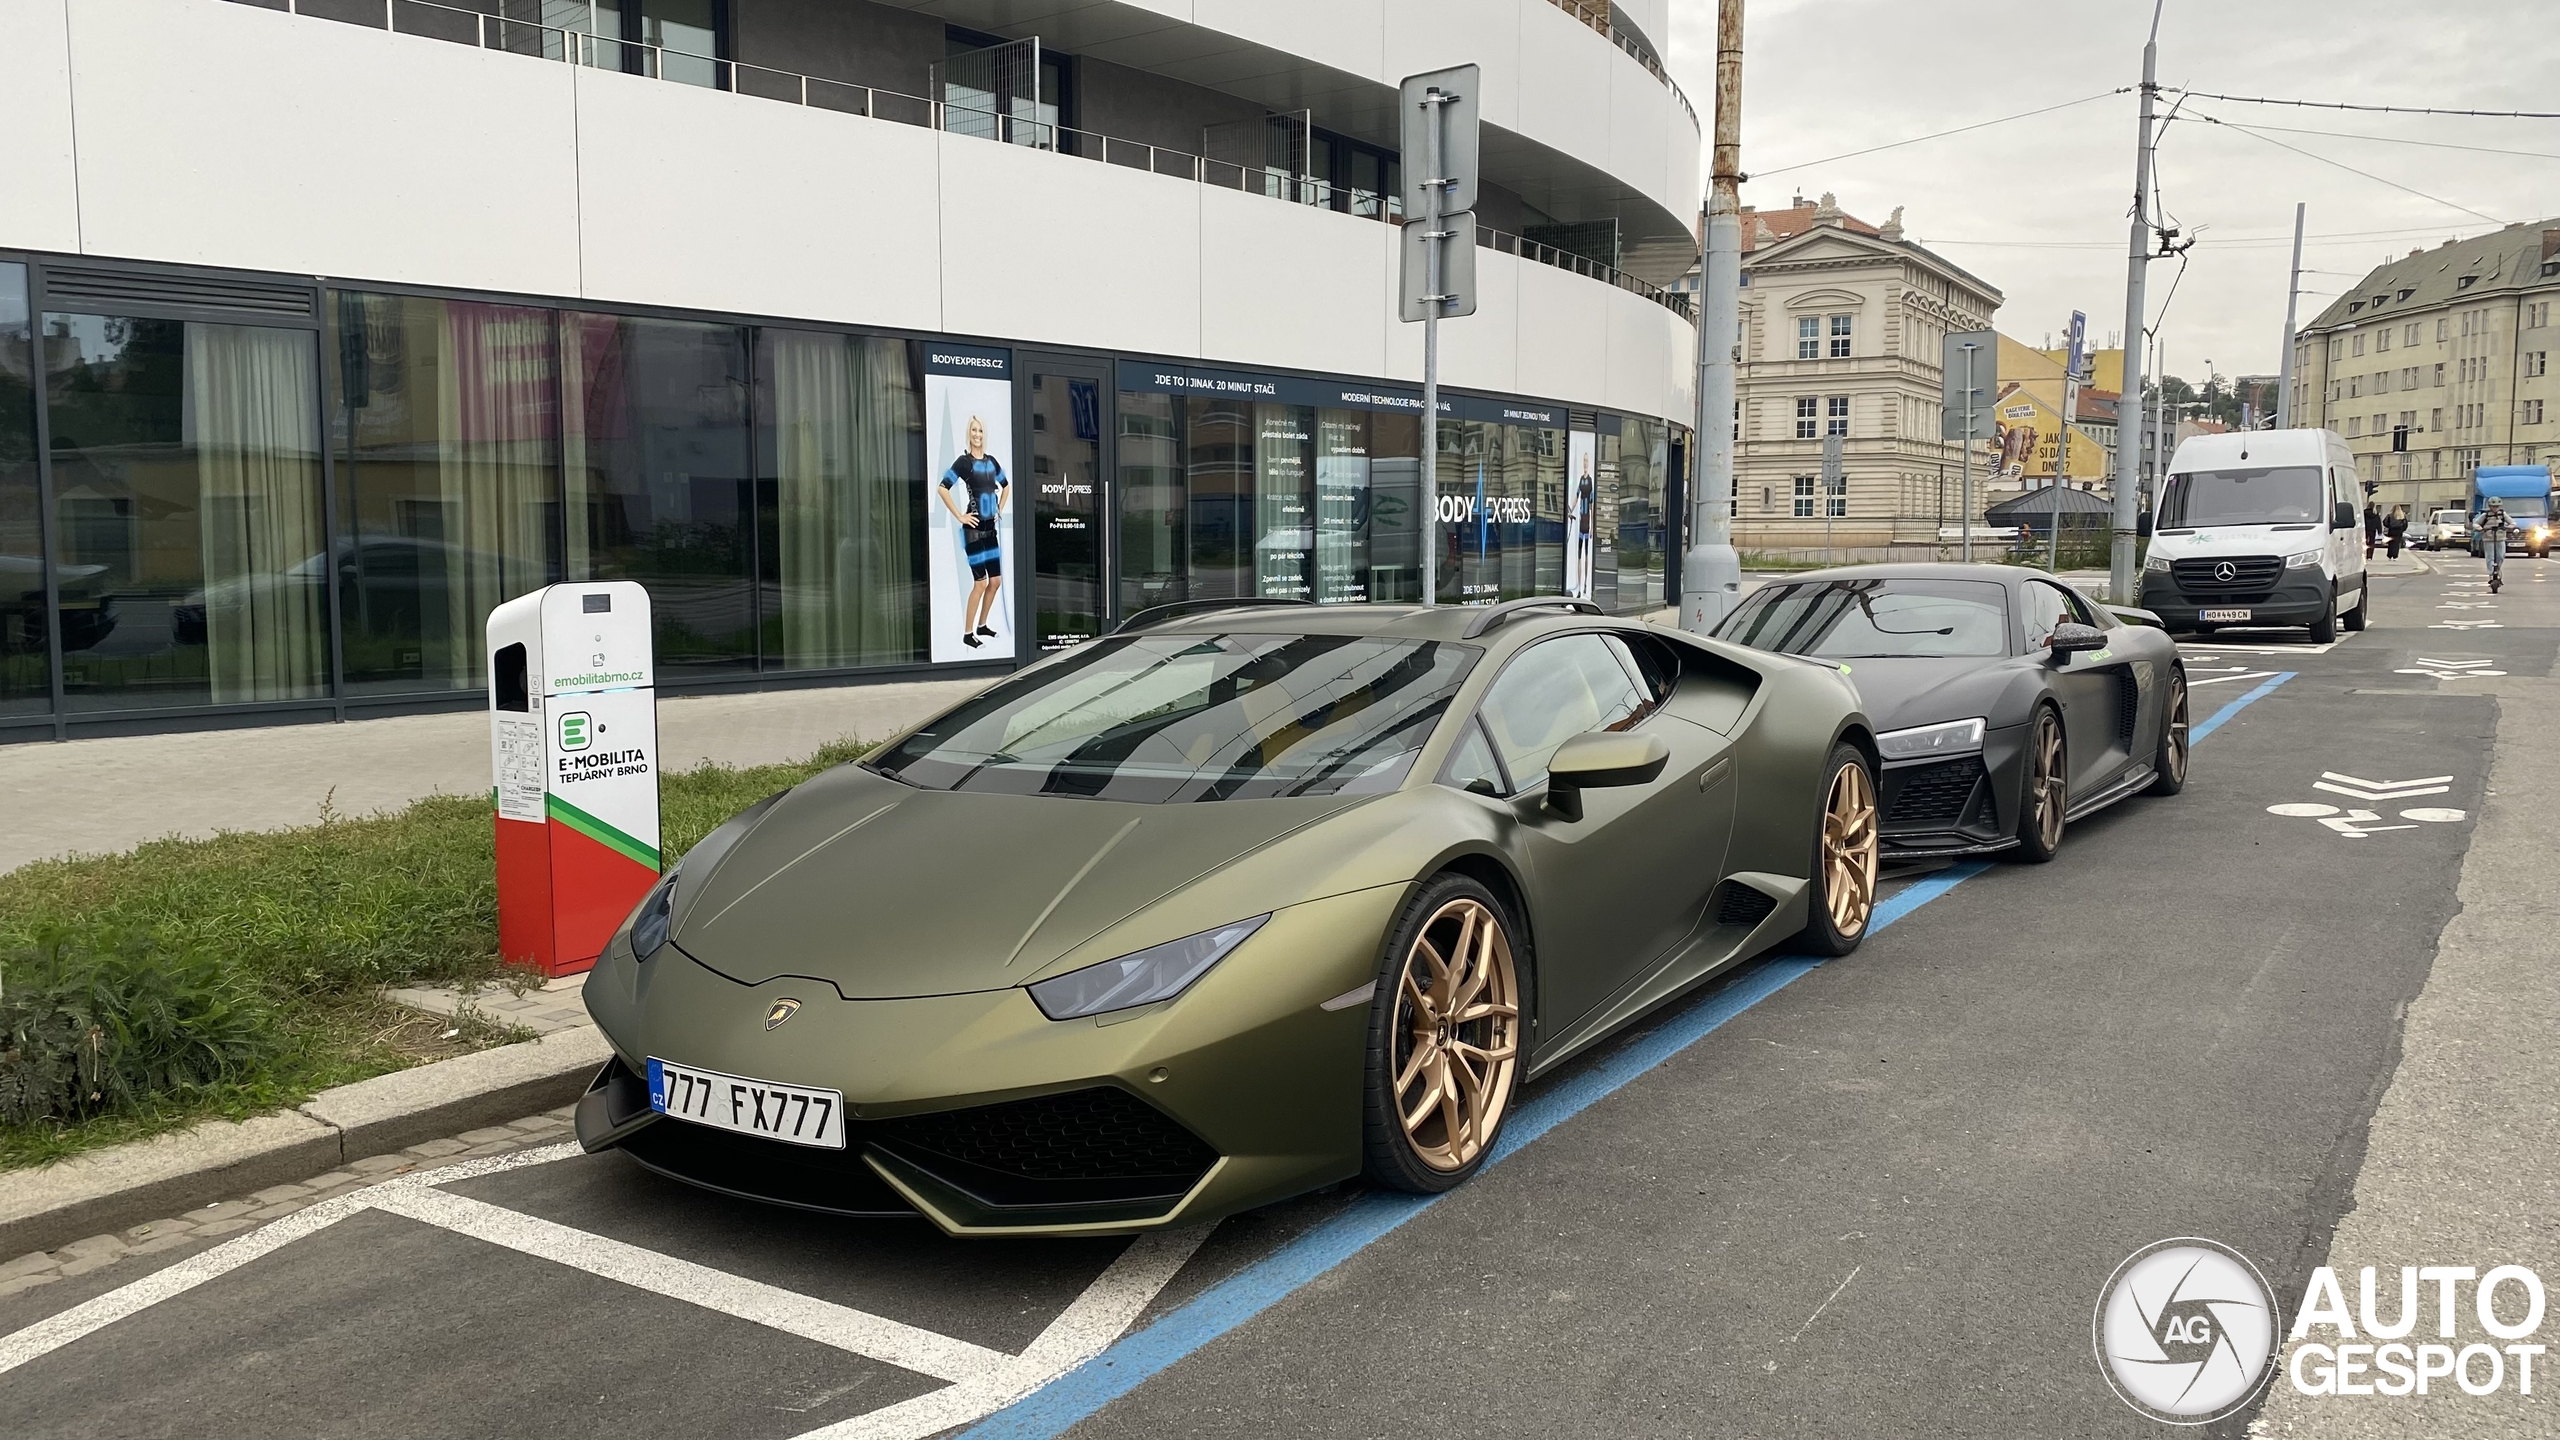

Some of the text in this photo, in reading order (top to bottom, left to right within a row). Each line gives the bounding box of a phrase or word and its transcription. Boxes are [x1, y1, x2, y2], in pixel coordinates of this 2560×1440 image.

[2074, 321, 2082, 356] P
[932, 354, 1003, 369] BODYEXPRESS.CZ
[1155, 374, 1171, 386] JDE
[1172, 376, 1184, 386] TO
[1216, 380, 1226, 390] 20
[1227, 382, 1252, 392] MINUT
[1341, 392, 1371, 403] MODERNÍ
[1372, 395, 1409, 407] TECHNOLOGIE
[2043, 433, 2072, 444] JAKU
[2040, 447, 2048, 458] SI
[2042, 461, 2070, 472] DNE?
[1042, 484, 1063, 494] BODY
[1486, 497, 1531, 524] EXPRESS
[1463, 585, 1473, 595] JDE
[1474, 585, 1480, 594] TO
[554, 672, 644, 687] emobilitabrno.cz
[559, 749, 645, 772] E-MOBILITA
[559, 764, 648, 784] TEPLÁRNY BRNO
[652, 1092, 664, 1107] CZ
[664, 1070, 832, 1139] 777 FX777
